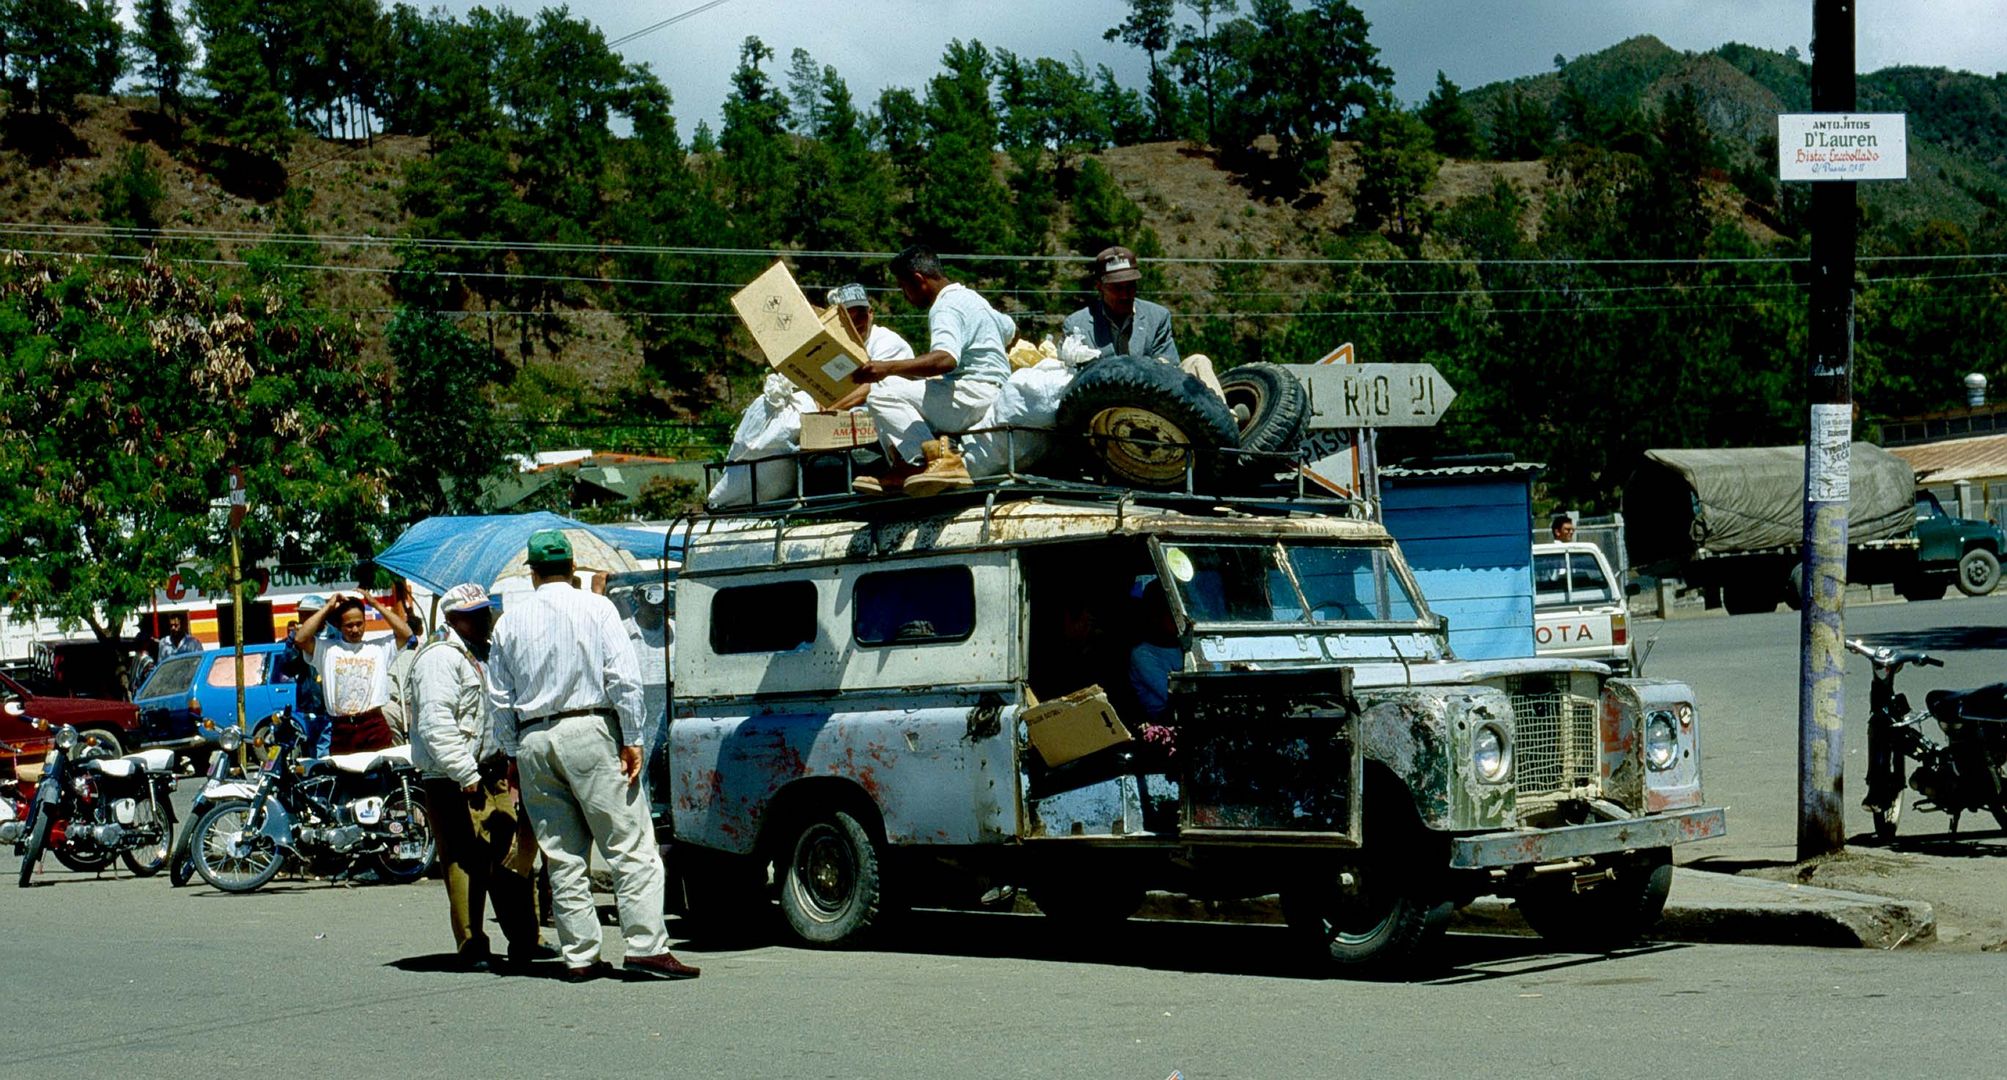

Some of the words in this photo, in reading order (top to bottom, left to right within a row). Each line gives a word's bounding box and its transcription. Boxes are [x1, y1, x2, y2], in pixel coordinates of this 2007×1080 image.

[1813, 121, 1870, 130] ANTOJITOS
[1805, 132, 1878, 147] D'Lauren
[1307, 376, 1324, 416] L
[1344, 375, 1390, 416] RIO
[1409, 375, 1436, 416] 21
[1301, 429, 1350, 469] PASO
[1536, 624, 1593, 644] OTA
